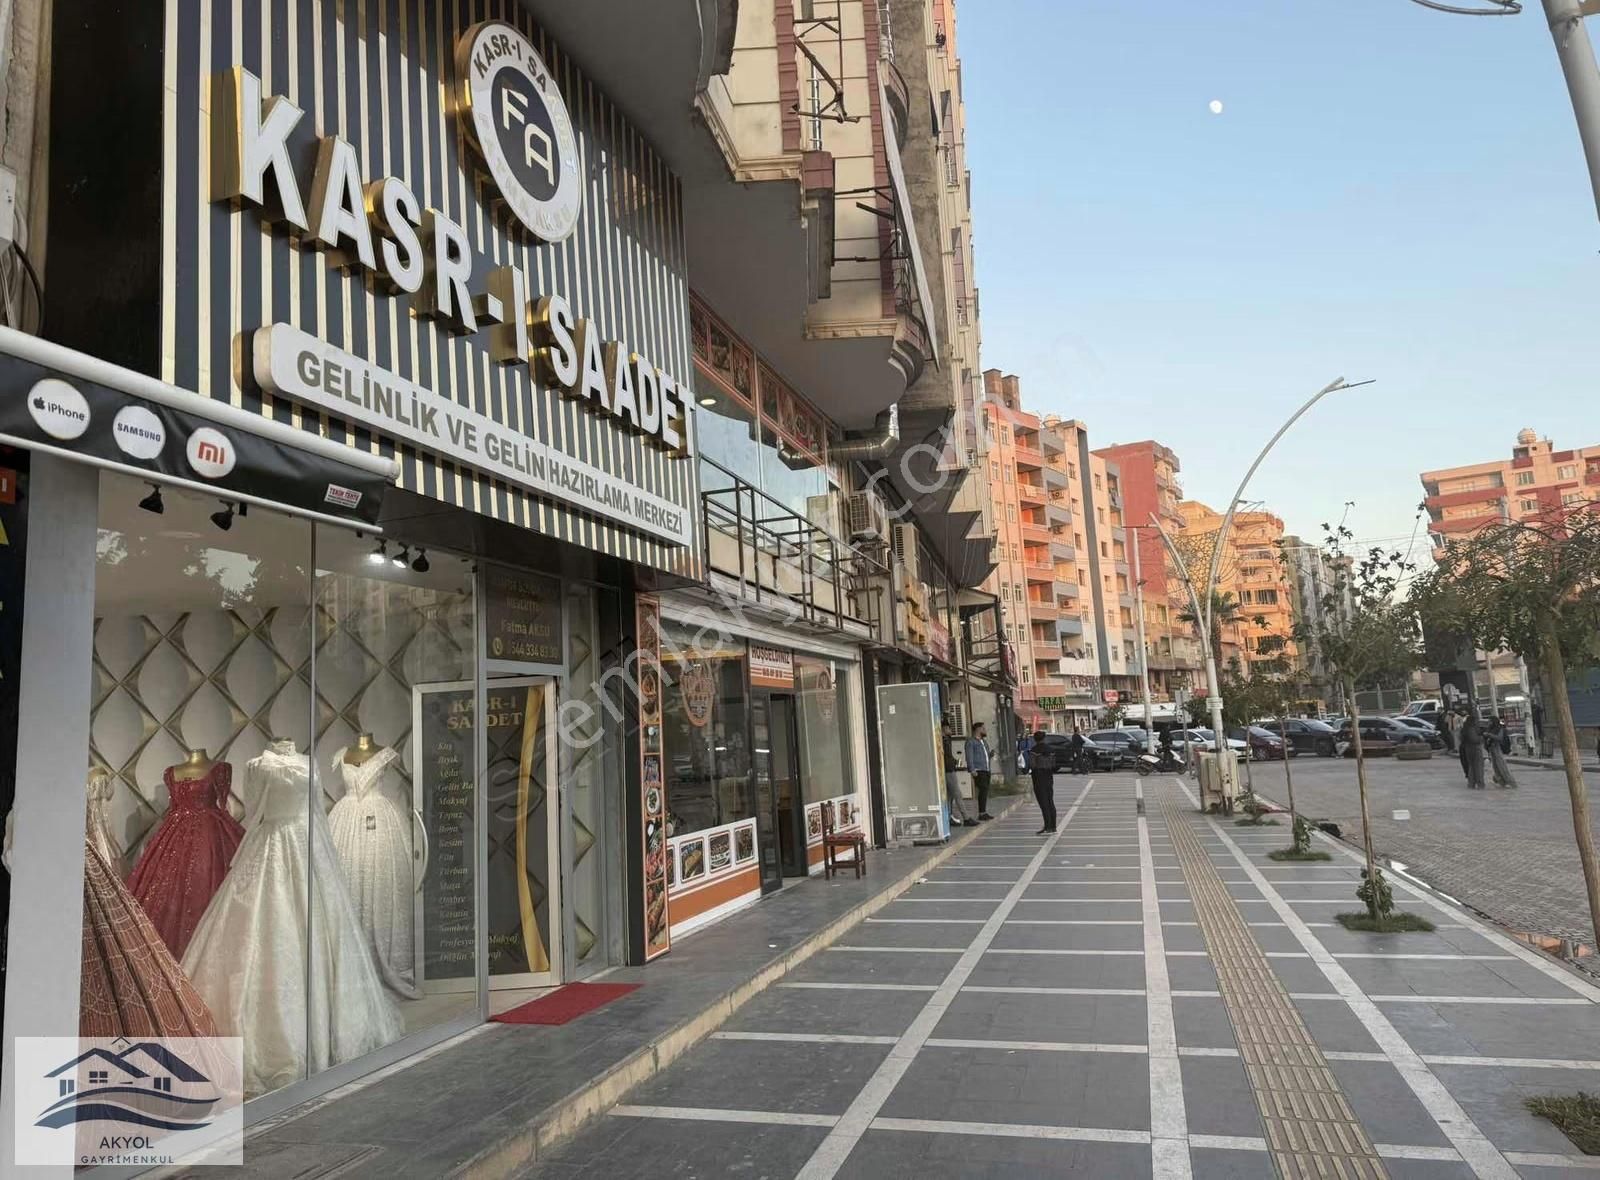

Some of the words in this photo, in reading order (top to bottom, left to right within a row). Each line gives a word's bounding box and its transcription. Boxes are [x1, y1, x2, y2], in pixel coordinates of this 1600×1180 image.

[474, 33, 523, 80] KASR-I
[238, 65, 529, 364] KASR-I
[549, 294, 696, 459] SAADET
[47, 402, 86, 421] iPhone
[117, 421, 162, 443] SAMSUNG
[296, 350, 440, 438] GELİNLİK
[446, 412, 478, 454] VE
[484, 432, 545, 481] GELİN
[549, 457, 632, 517] HAZIRLAMA
[634, 495, 684, 536] MERKEZİ
[452, 695, 517, 713] KAR-I
[447, 712, 522, 730] SADET
